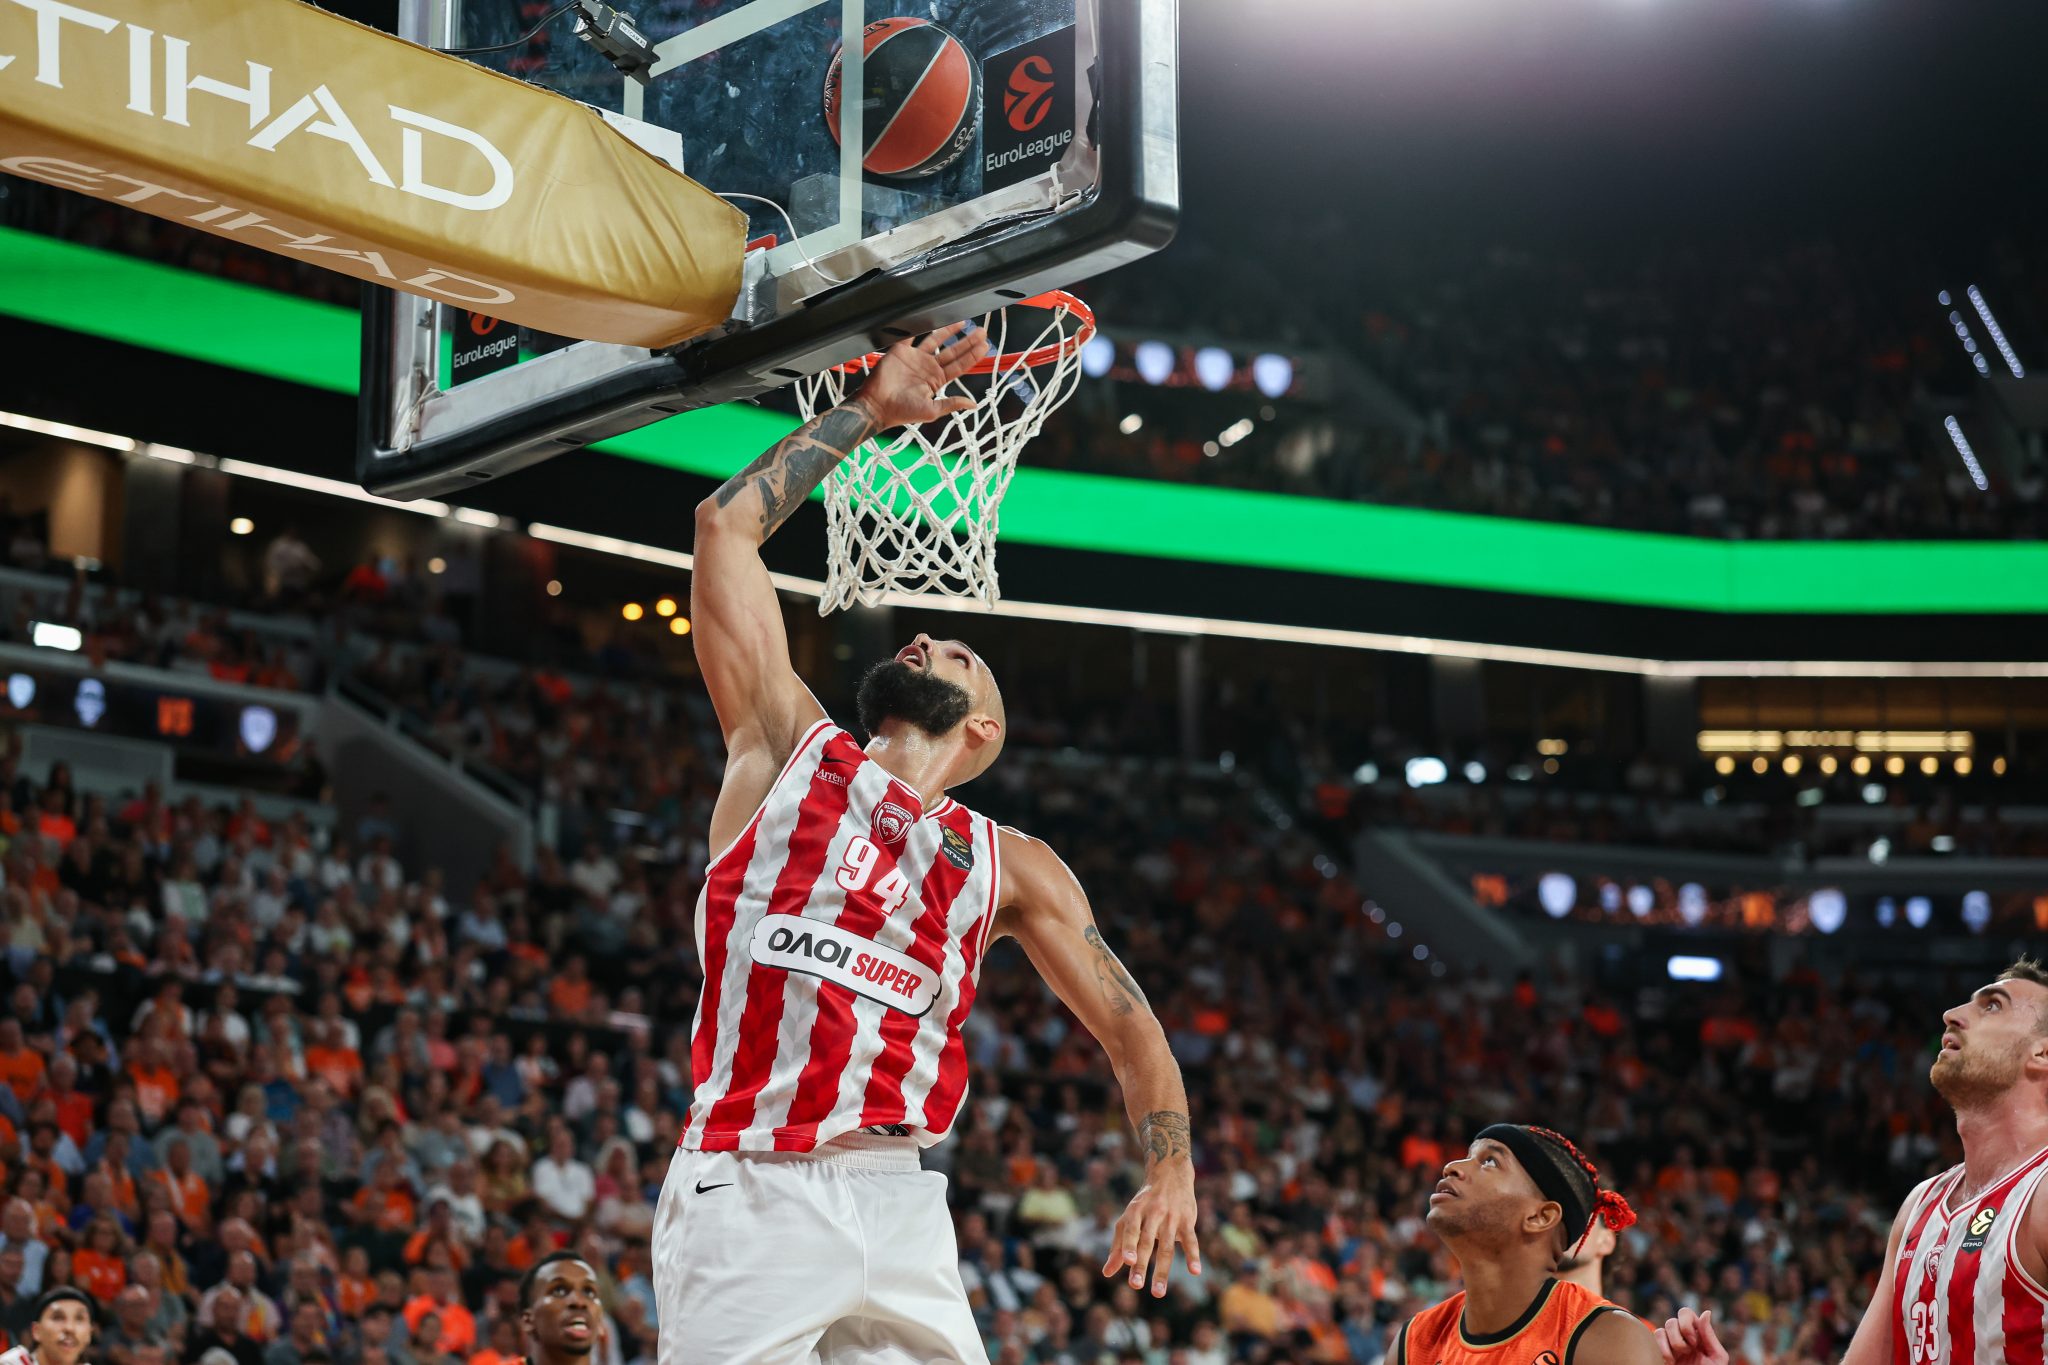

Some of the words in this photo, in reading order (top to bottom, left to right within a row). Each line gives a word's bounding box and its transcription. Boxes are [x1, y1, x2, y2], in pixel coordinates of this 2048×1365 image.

[0, 0, 514, 211] TIHAD
[985, 129, 1072, 172] EuroLeague
[0, 156, 515, 304] ETIHAD
[453, 335, 517, 368] EuroLeague
[835, 836, 911, 917] 94
[851, 953, 922, 999] SUPER
[1911, 1299, 1940, 1363] 33
